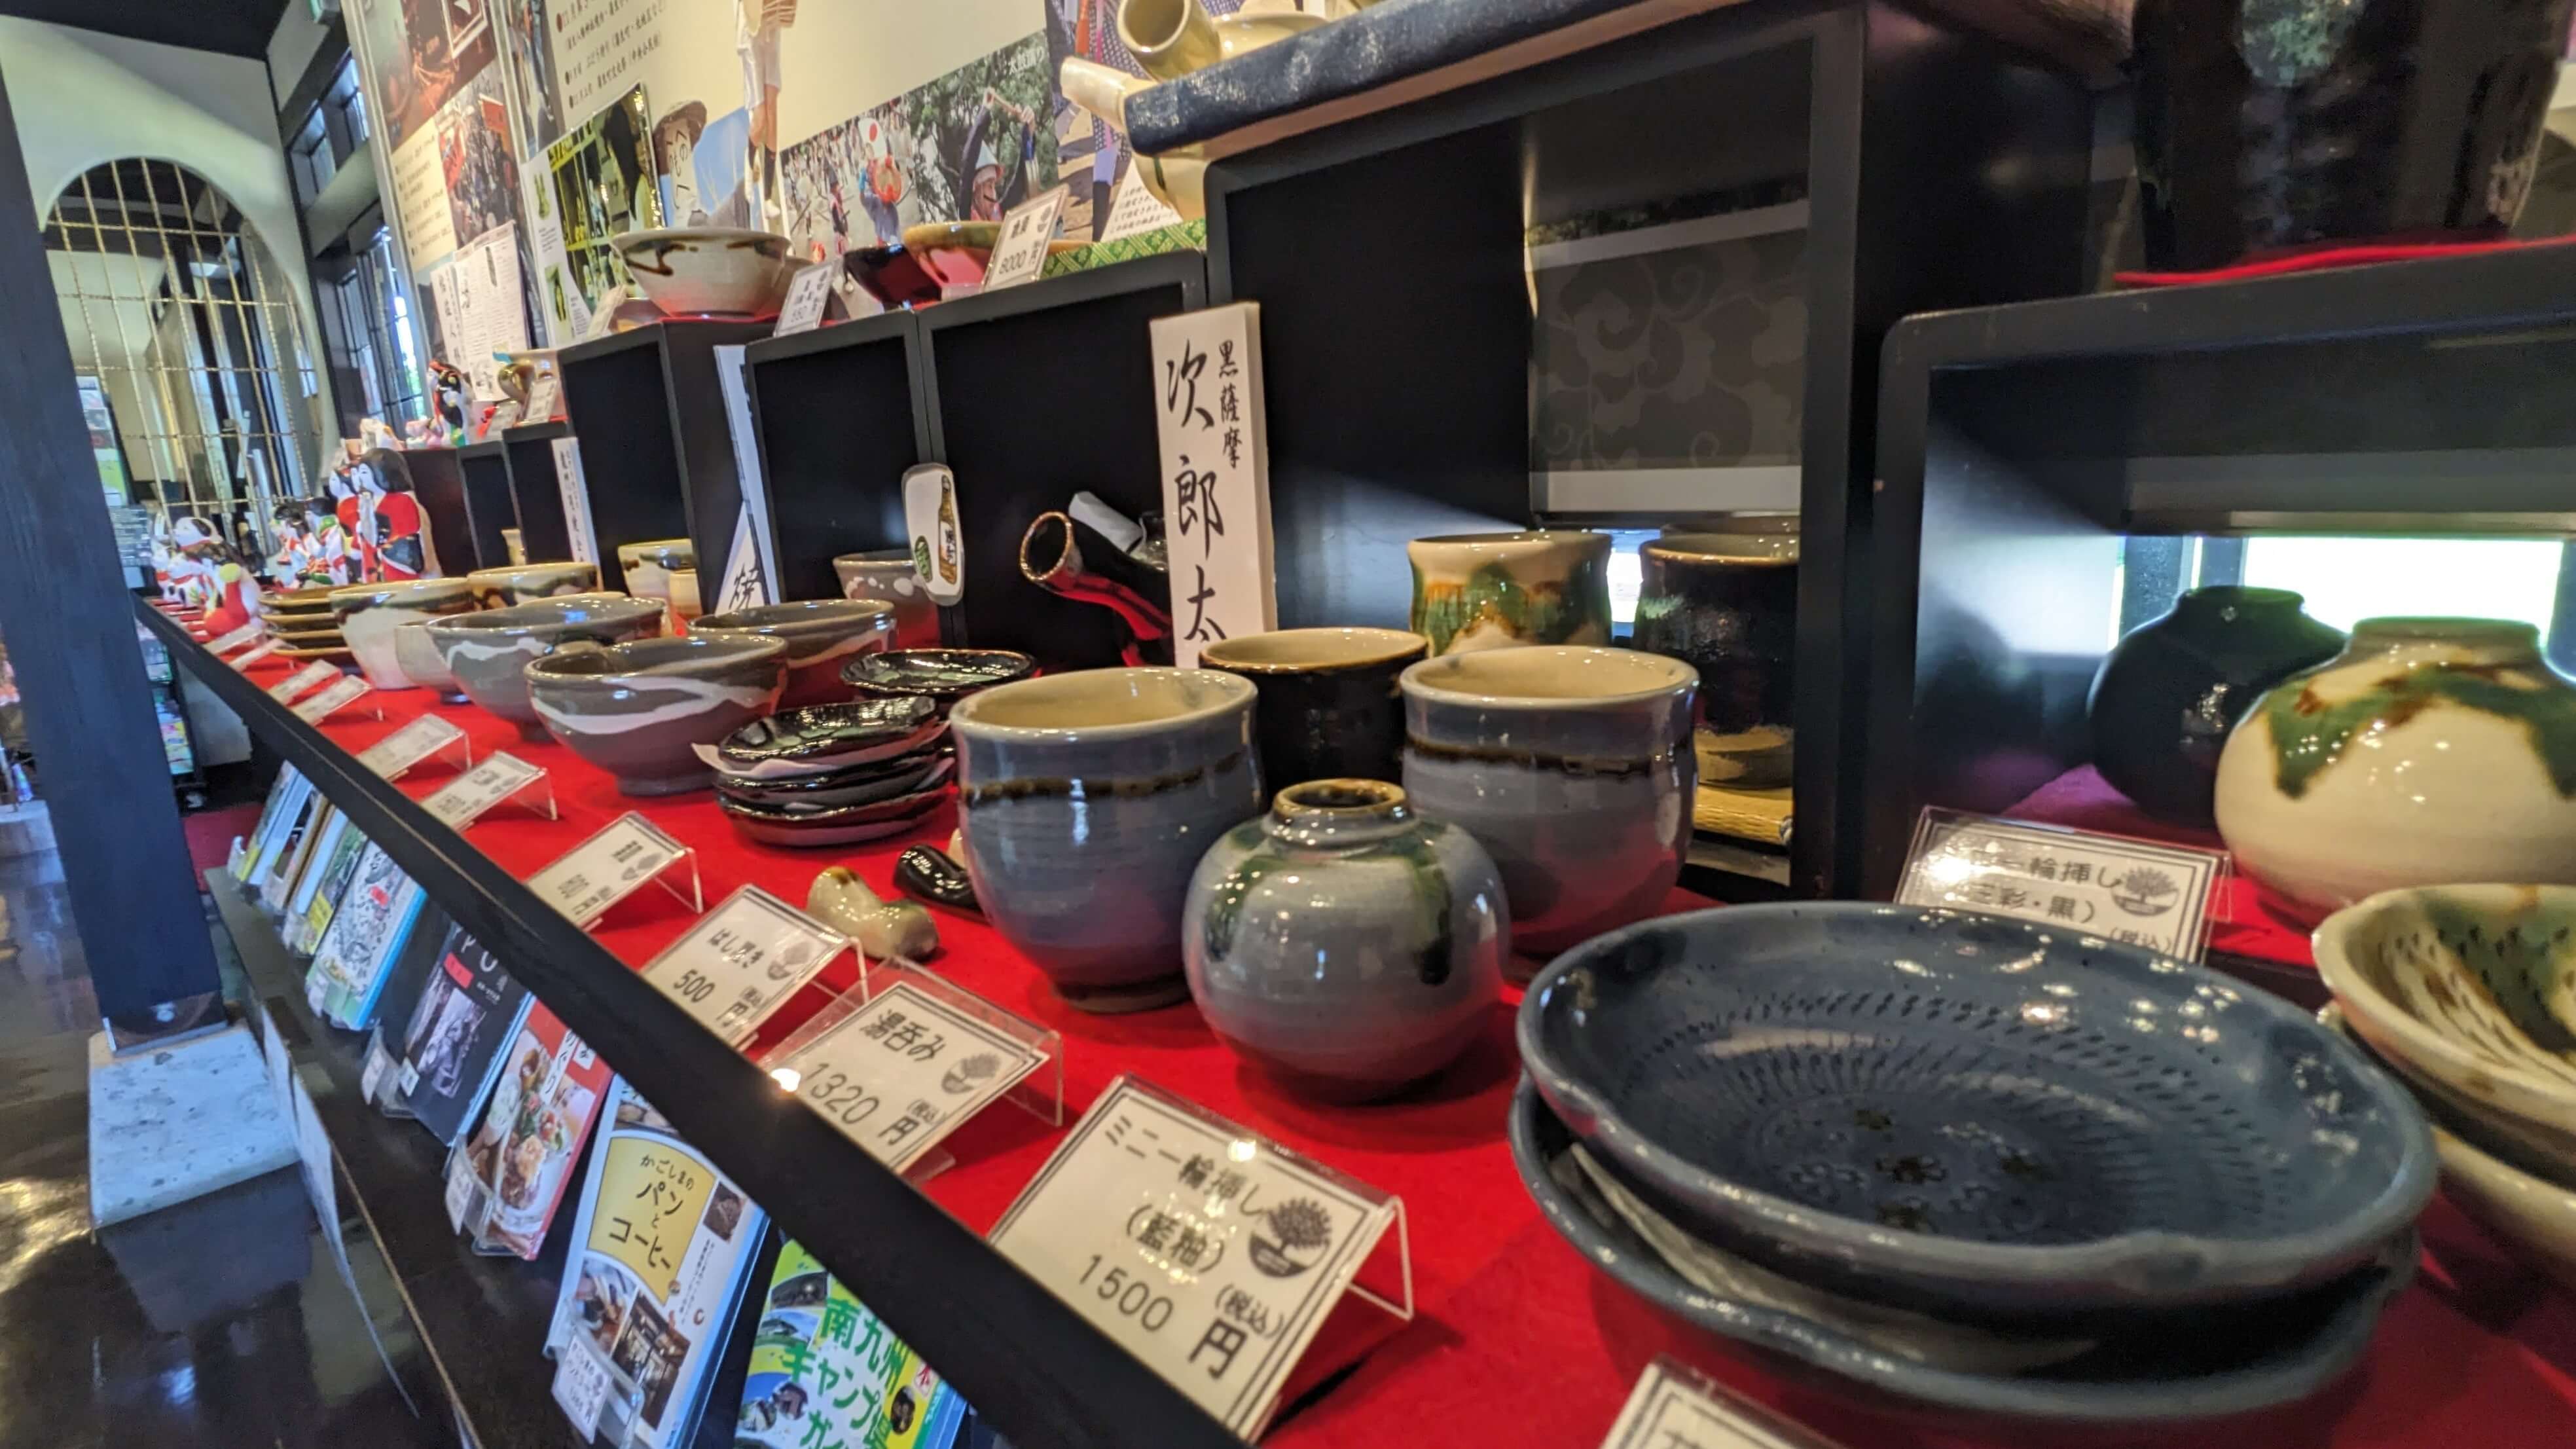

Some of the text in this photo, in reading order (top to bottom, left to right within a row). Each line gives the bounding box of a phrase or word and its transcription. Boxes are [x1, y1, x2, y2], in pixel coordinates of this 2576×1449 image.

[1218, 339, 1243, 469] 黒薩摩
[1166, 339, 1227, 644] 次郎太
[673, 969, 716, 1003] 500
[860, 1009, 947, 1062] 湯呑み
[806, 1063, 920, 1146] 1320 円
[636, 1181, 684, 1215] パン
[640, 1154, 695, 1191] かごしまの
[608, 1216, 672, 1270] コーヒー
[1079, 1253, 1248, 1380] 1500 円
[1214, 1283, 1286, 1340] (税込)
[819, 1296, 911, 1396] 南九州
